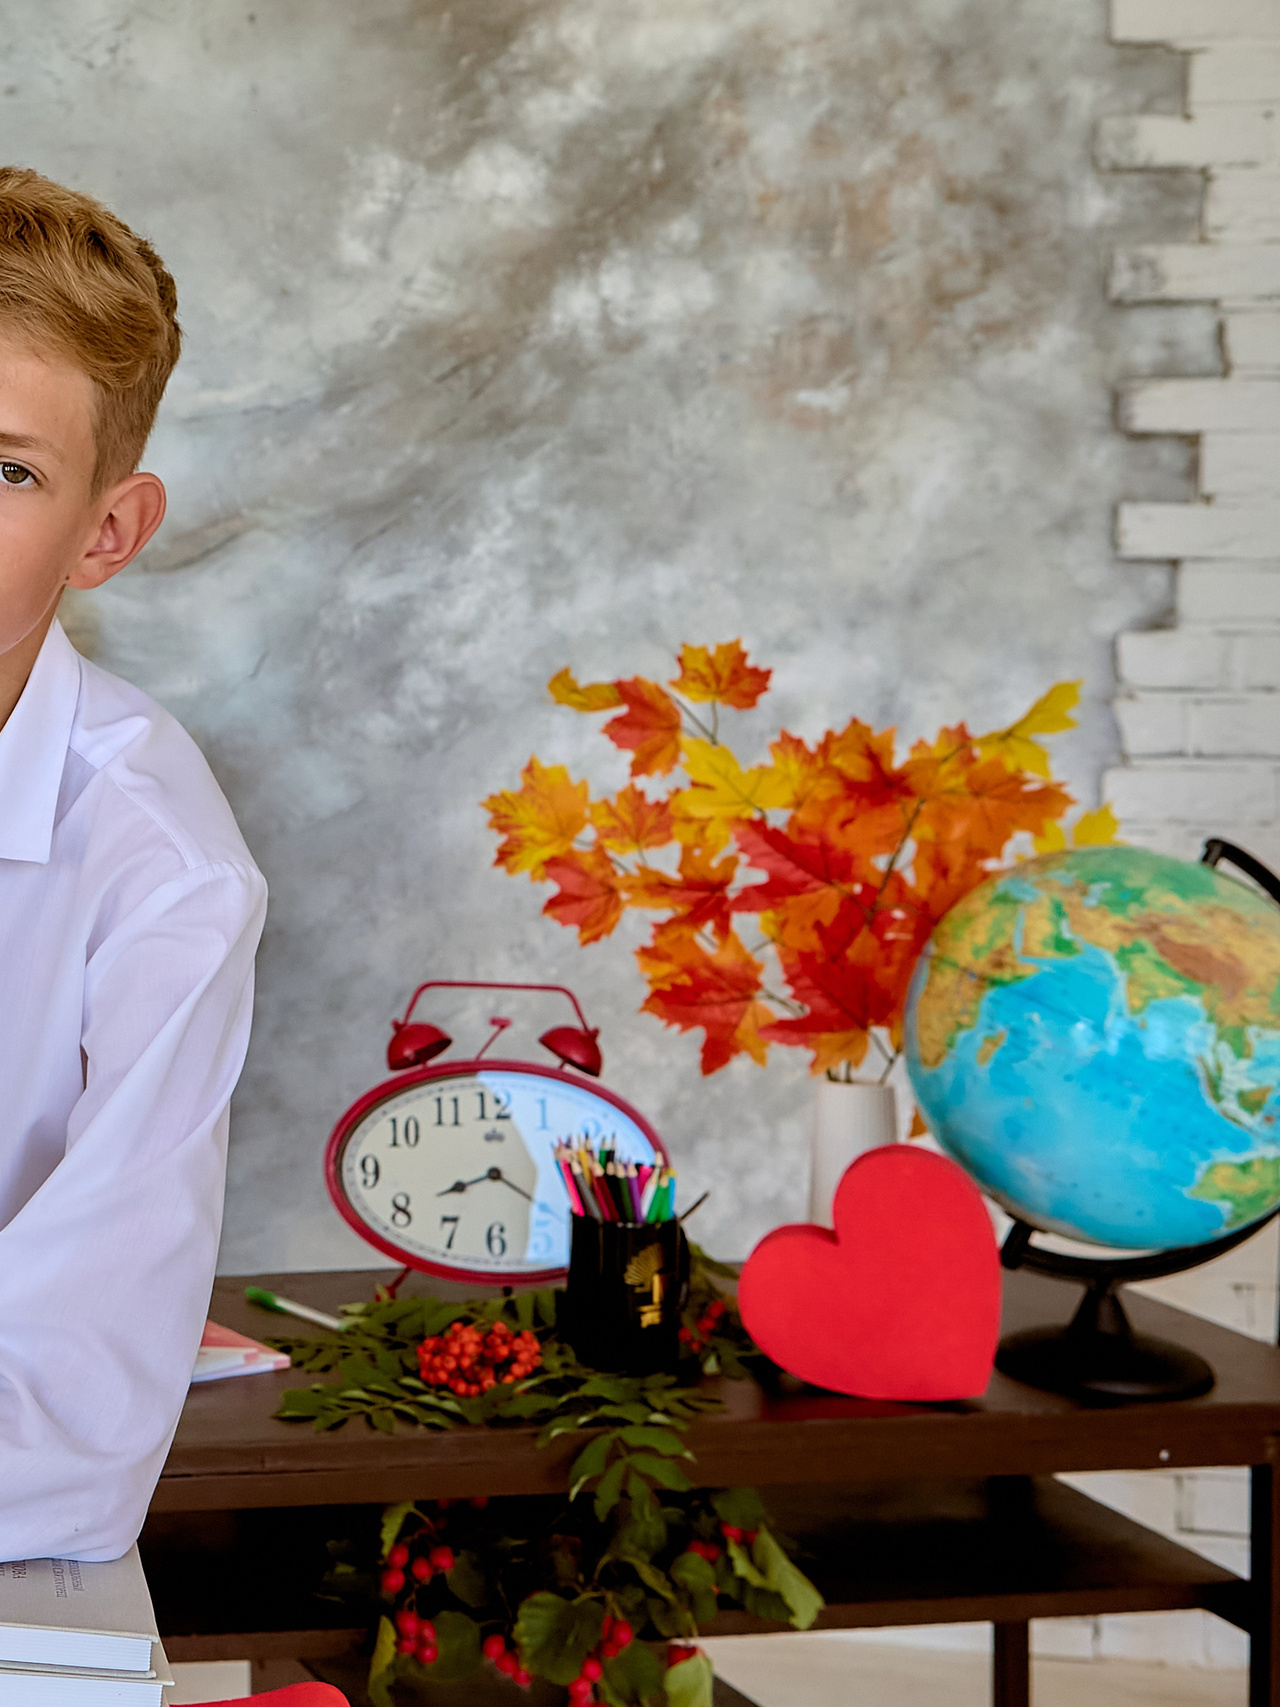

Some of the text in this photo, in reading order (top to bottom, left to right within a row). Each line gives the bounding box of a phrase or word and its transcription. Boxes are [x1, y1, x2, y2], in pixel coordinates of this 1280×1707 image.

[435, 1096, 461, 1127] 11
[475, 1090, 512, 1121] 12
[536, 1097, 551, 1131] 1
[389, 1115, 420, 1148] 10
[361, 1154, 380, 1188] 9
[391, 1192, 413, 1228] 8
[440, 1215, 461, 1249] 7
[486, 1222, 507, 1257] 6
[533, 1220, 554, 1253] 5
